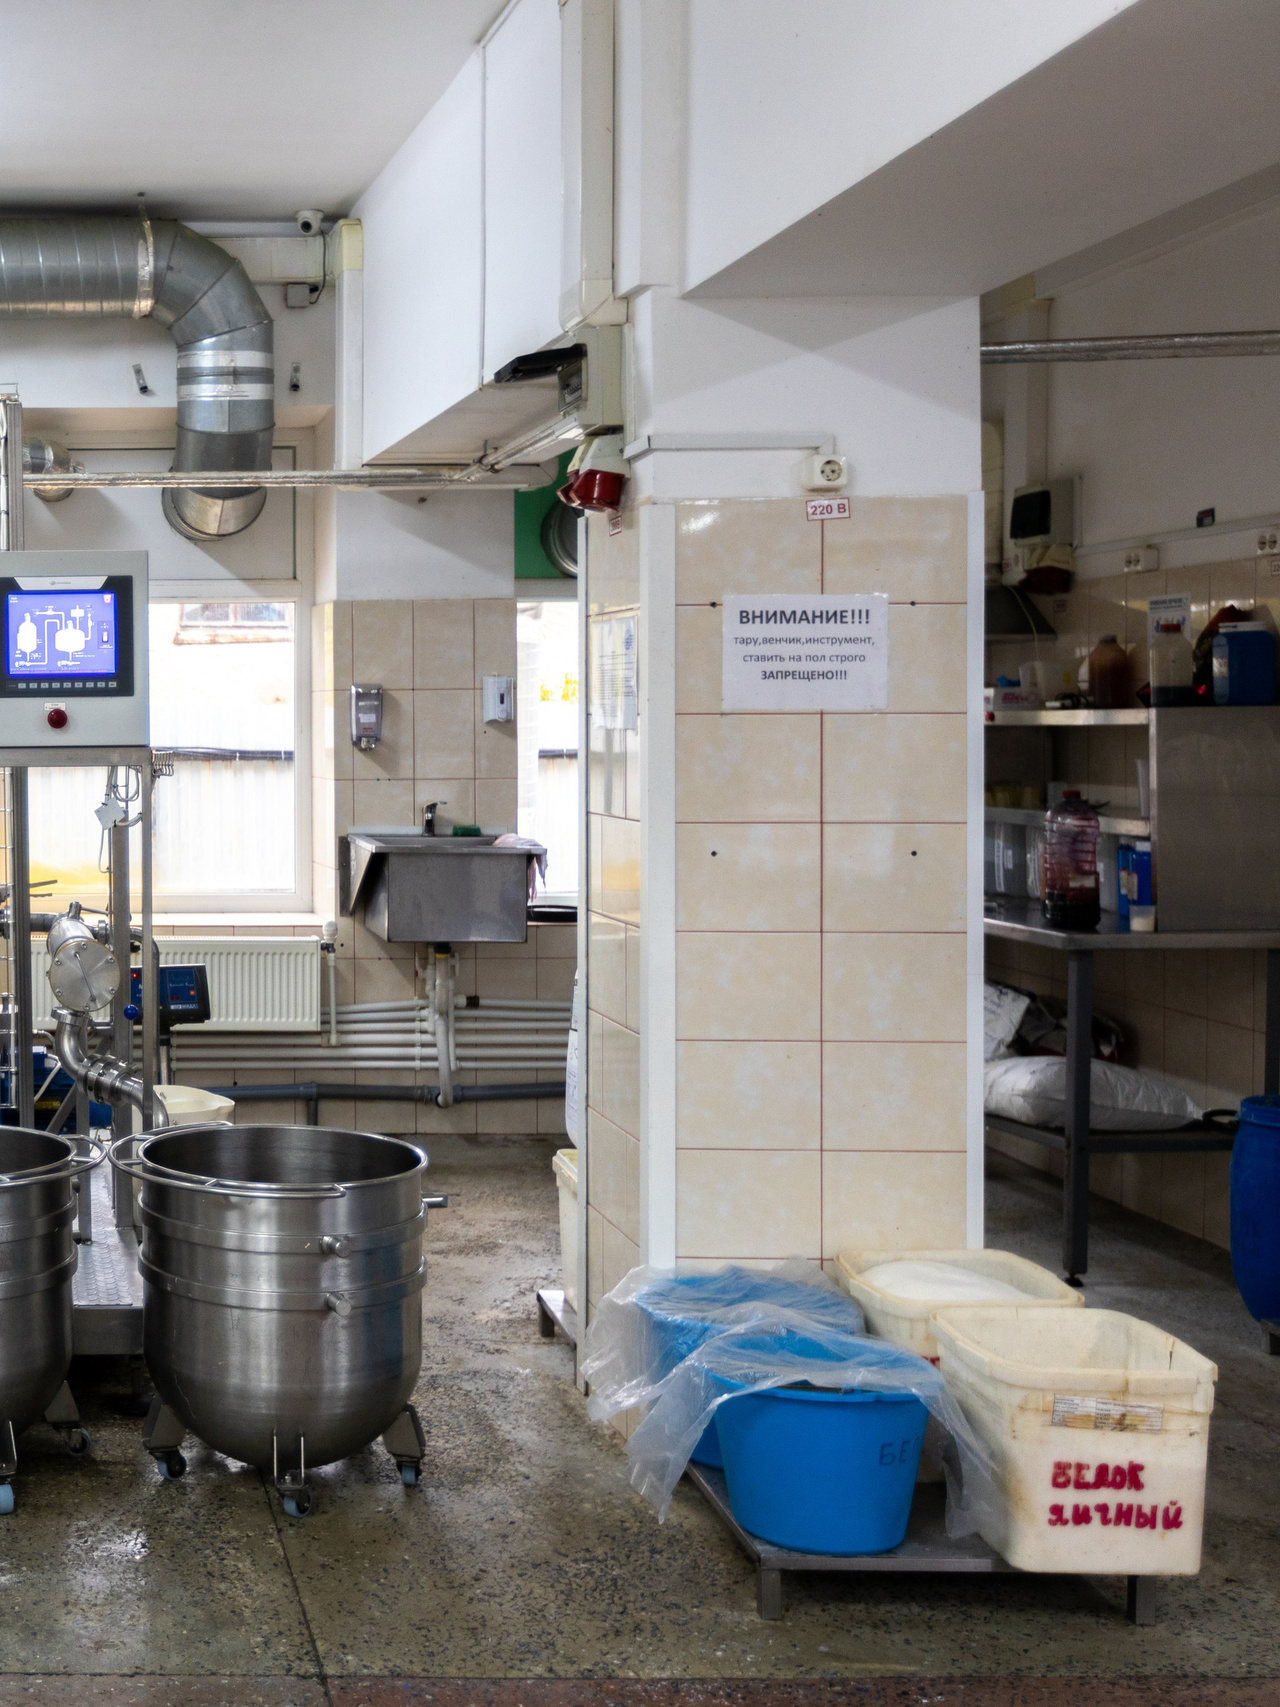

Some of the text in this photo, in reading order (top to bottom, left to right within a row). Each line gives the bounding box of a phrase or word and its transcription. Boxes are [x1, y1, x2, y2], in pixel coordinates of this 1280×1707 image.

[810, 504, 833, 516] 220
[739, 609, 870, 624] ВНИМАНИЕ!!!
[742, 653, 866, 665] ставить на пол строго
[760, 669, 848, 683] ЗАПРЕЩЕНО!!!
[1051, 1460, 1145, 1491] БЕЛОК
